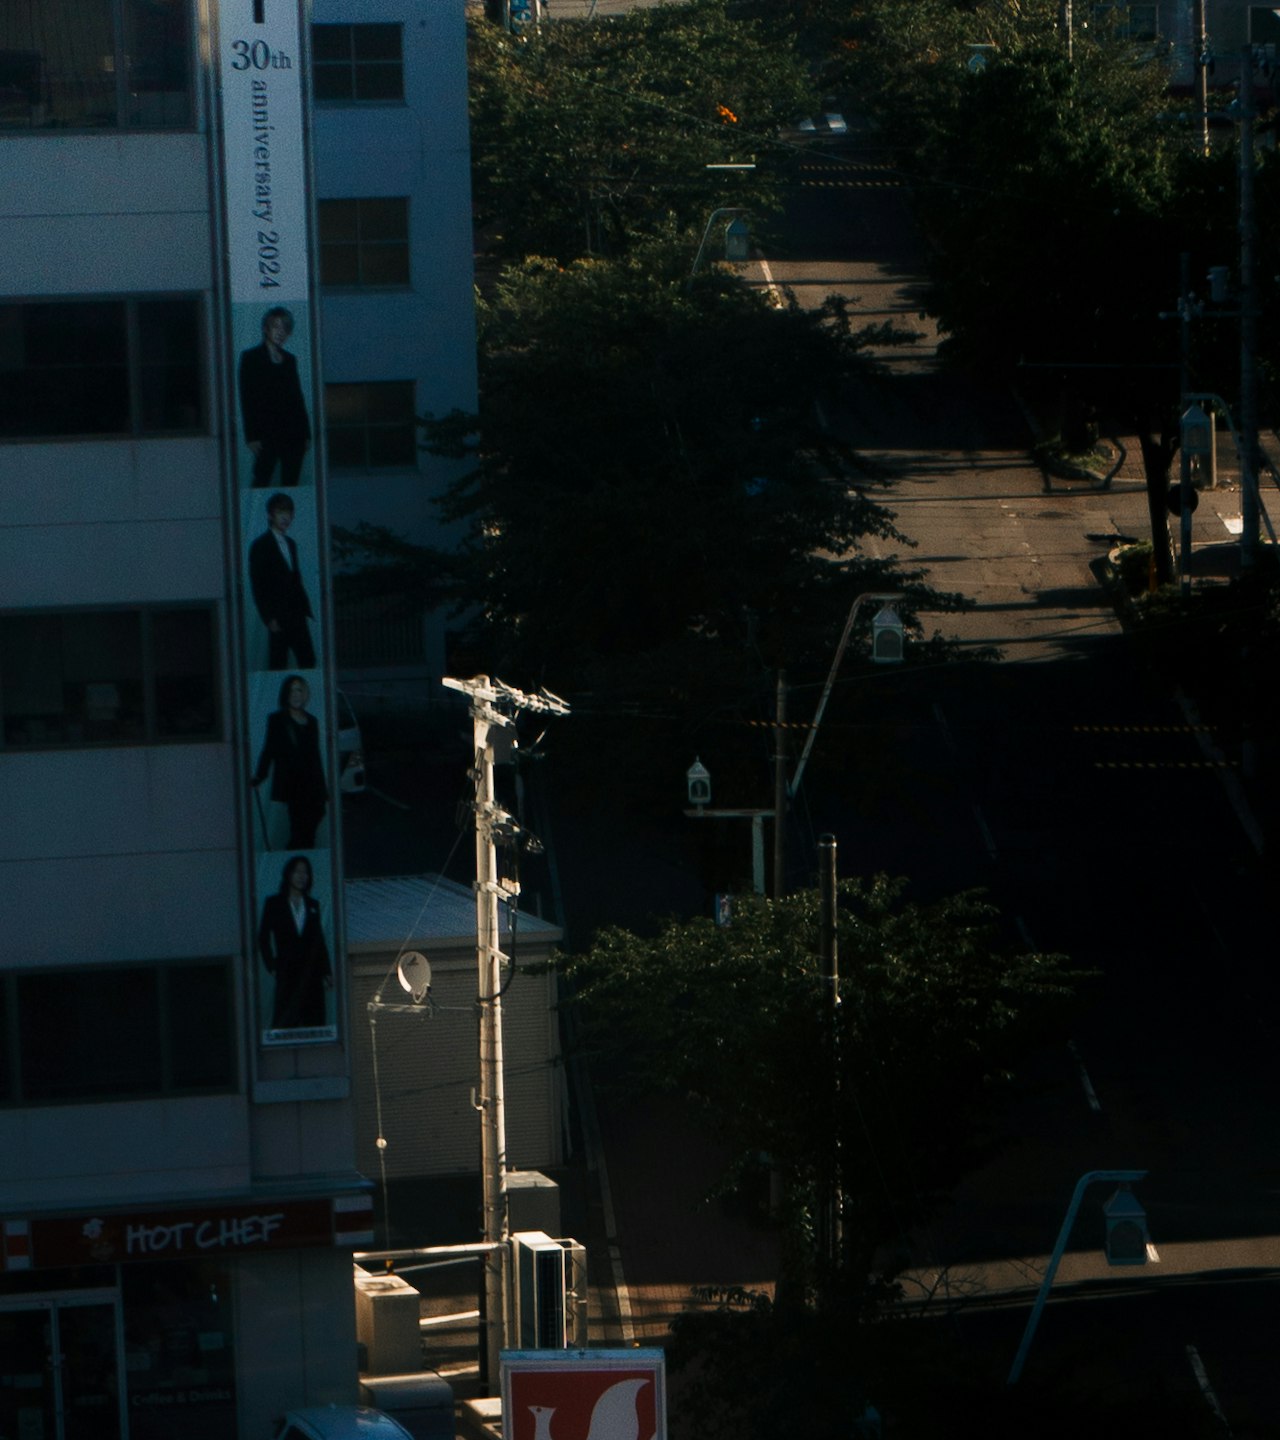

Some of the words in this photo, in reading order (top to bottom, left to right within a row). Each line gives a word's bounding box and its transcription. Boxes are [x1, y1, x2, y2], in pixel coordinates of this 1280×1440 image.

[231, 39, 292, 71] 30th
[251, 79, 275, 224] anniversary
[258, 231, 280, 289] 2024
[126, 1221, 194, 1254] HOT
[194, 1213, 286, 1250] CHEF
